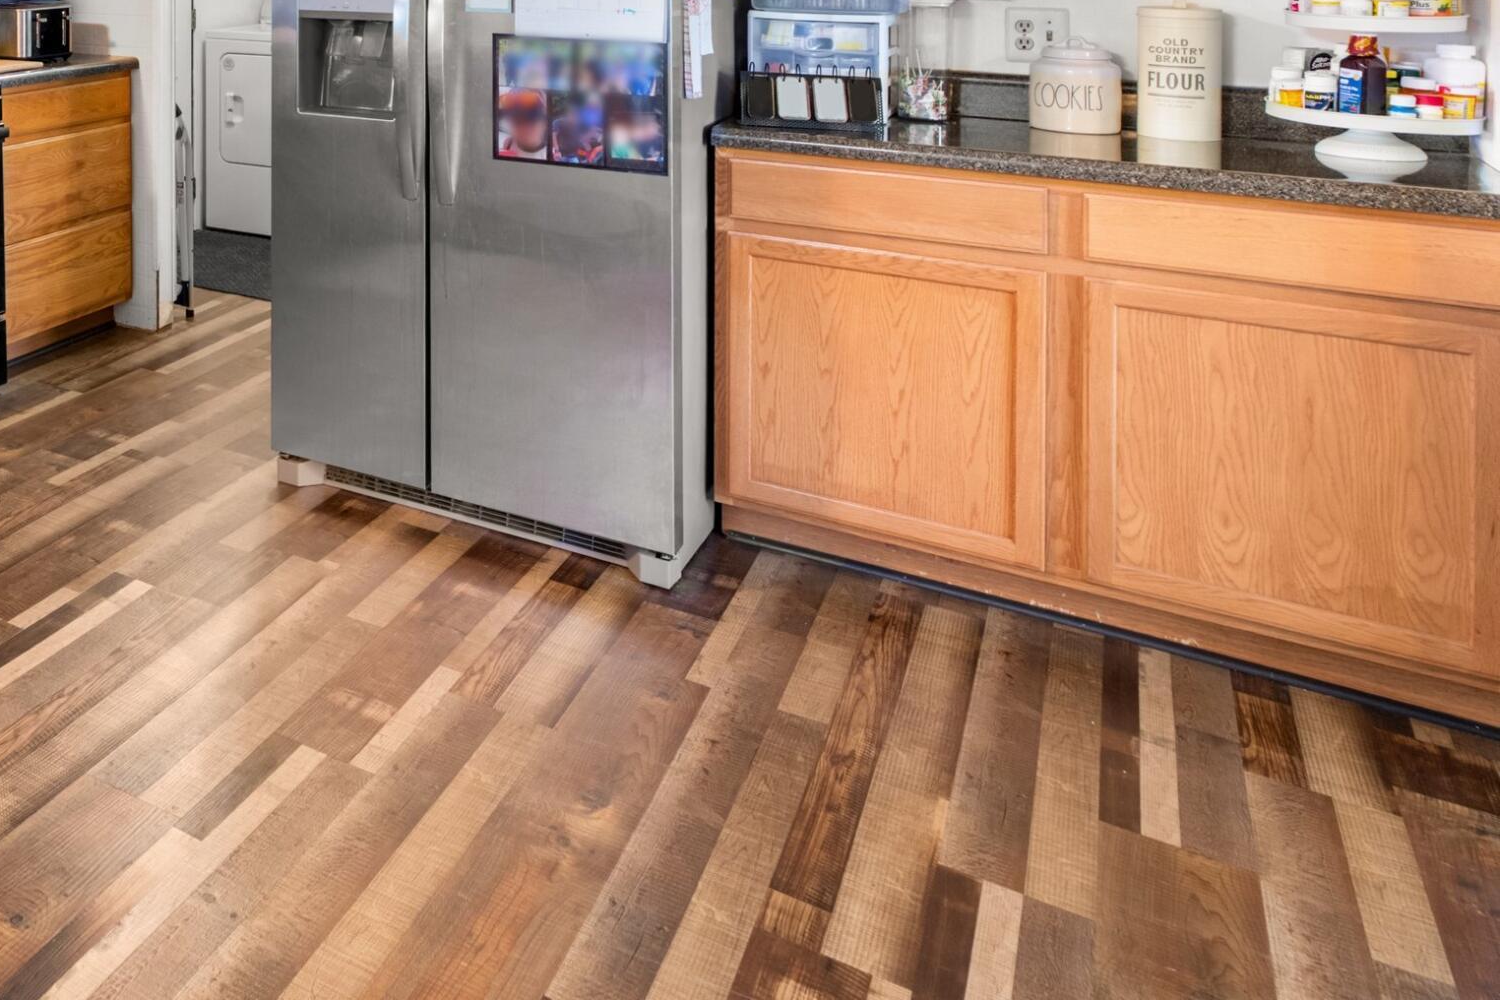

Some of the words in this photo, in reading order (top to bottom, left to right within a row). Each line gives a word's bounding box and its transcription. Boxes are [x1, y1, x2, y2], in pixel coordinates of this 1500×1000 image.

[1162, 38, 1189, 46] OLD
[1148, 46, 1205, 55] COUNTRY
[1155, 55, 1197, 64] BRAND
[1147, 71, 1205, 91] FLOUR
[1034, 81, 1103, 111] COOKIES
